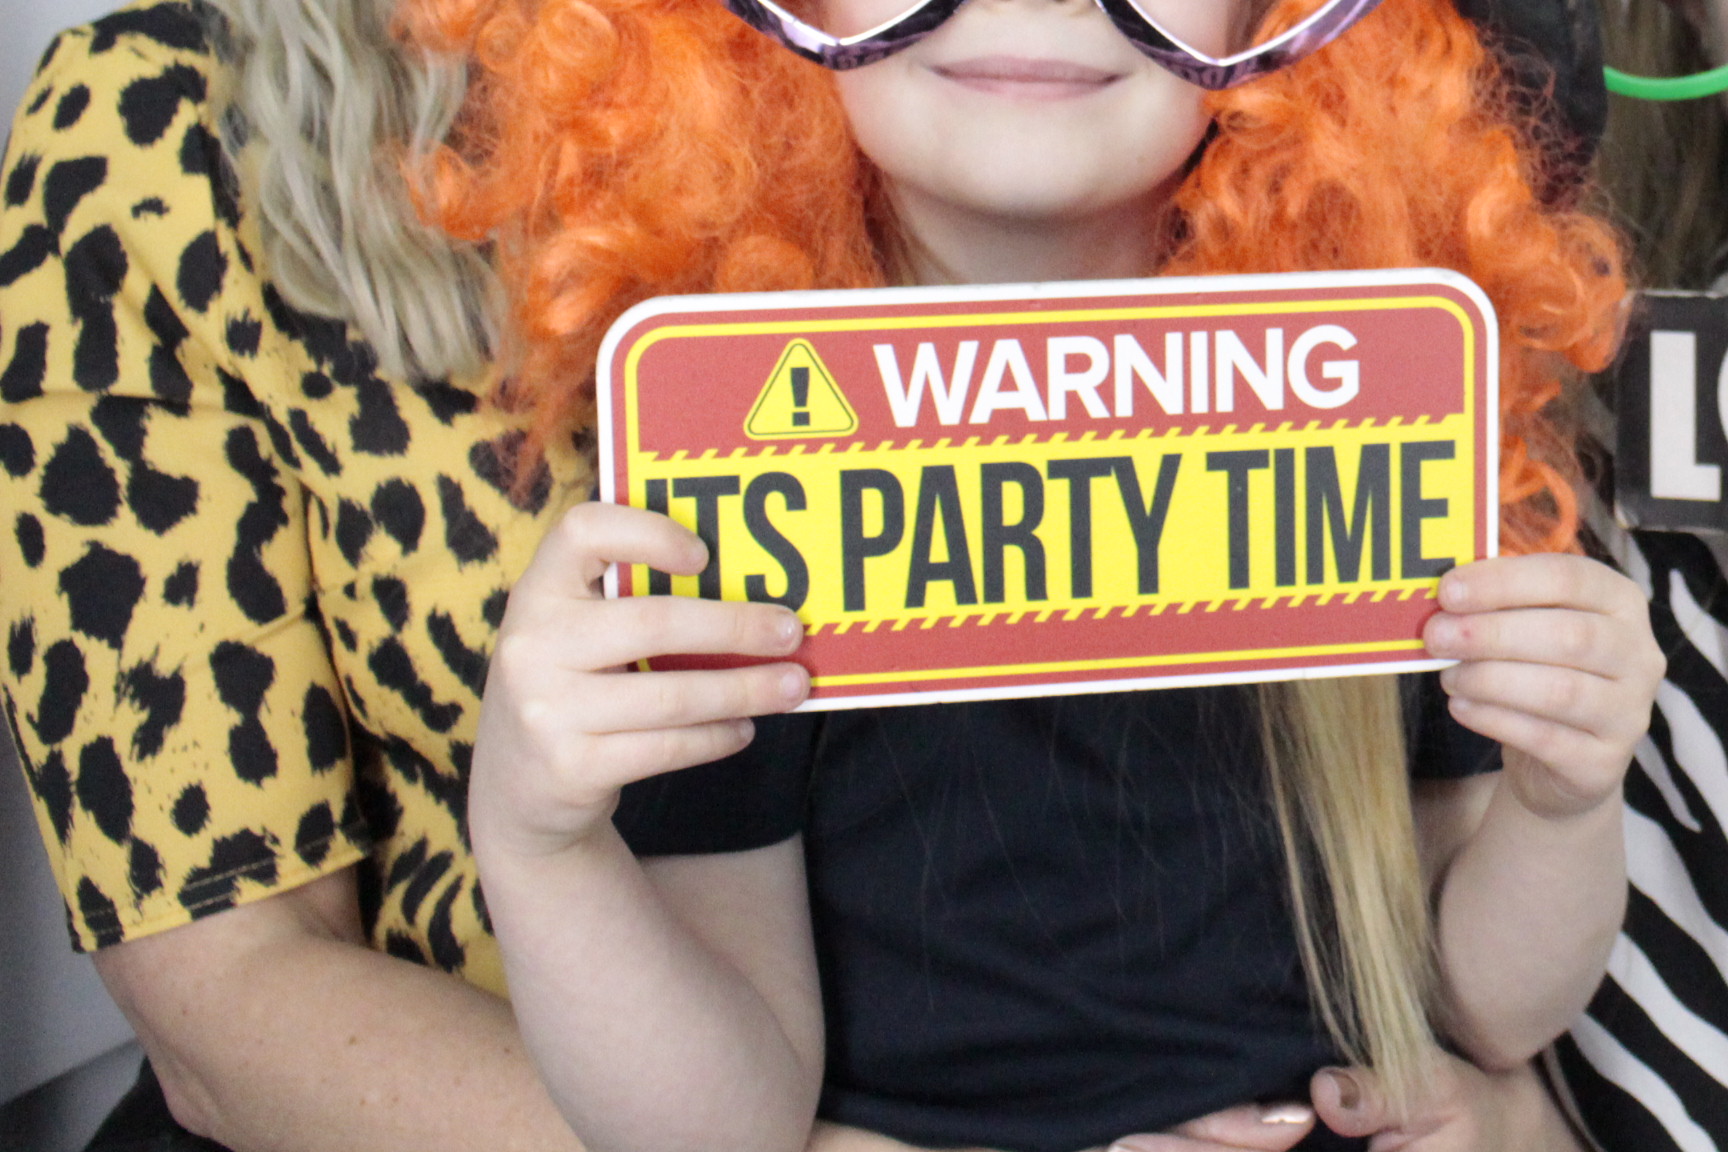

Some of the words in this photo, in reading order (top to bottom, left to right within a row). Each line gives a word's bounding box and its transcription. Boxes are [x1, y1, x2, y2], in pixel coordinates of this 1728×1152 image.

[872, 323, 1361, 428] WARNING
[838, 452, 1183, 612] PARTY
[1205, 439, 1457, 590] TIME
